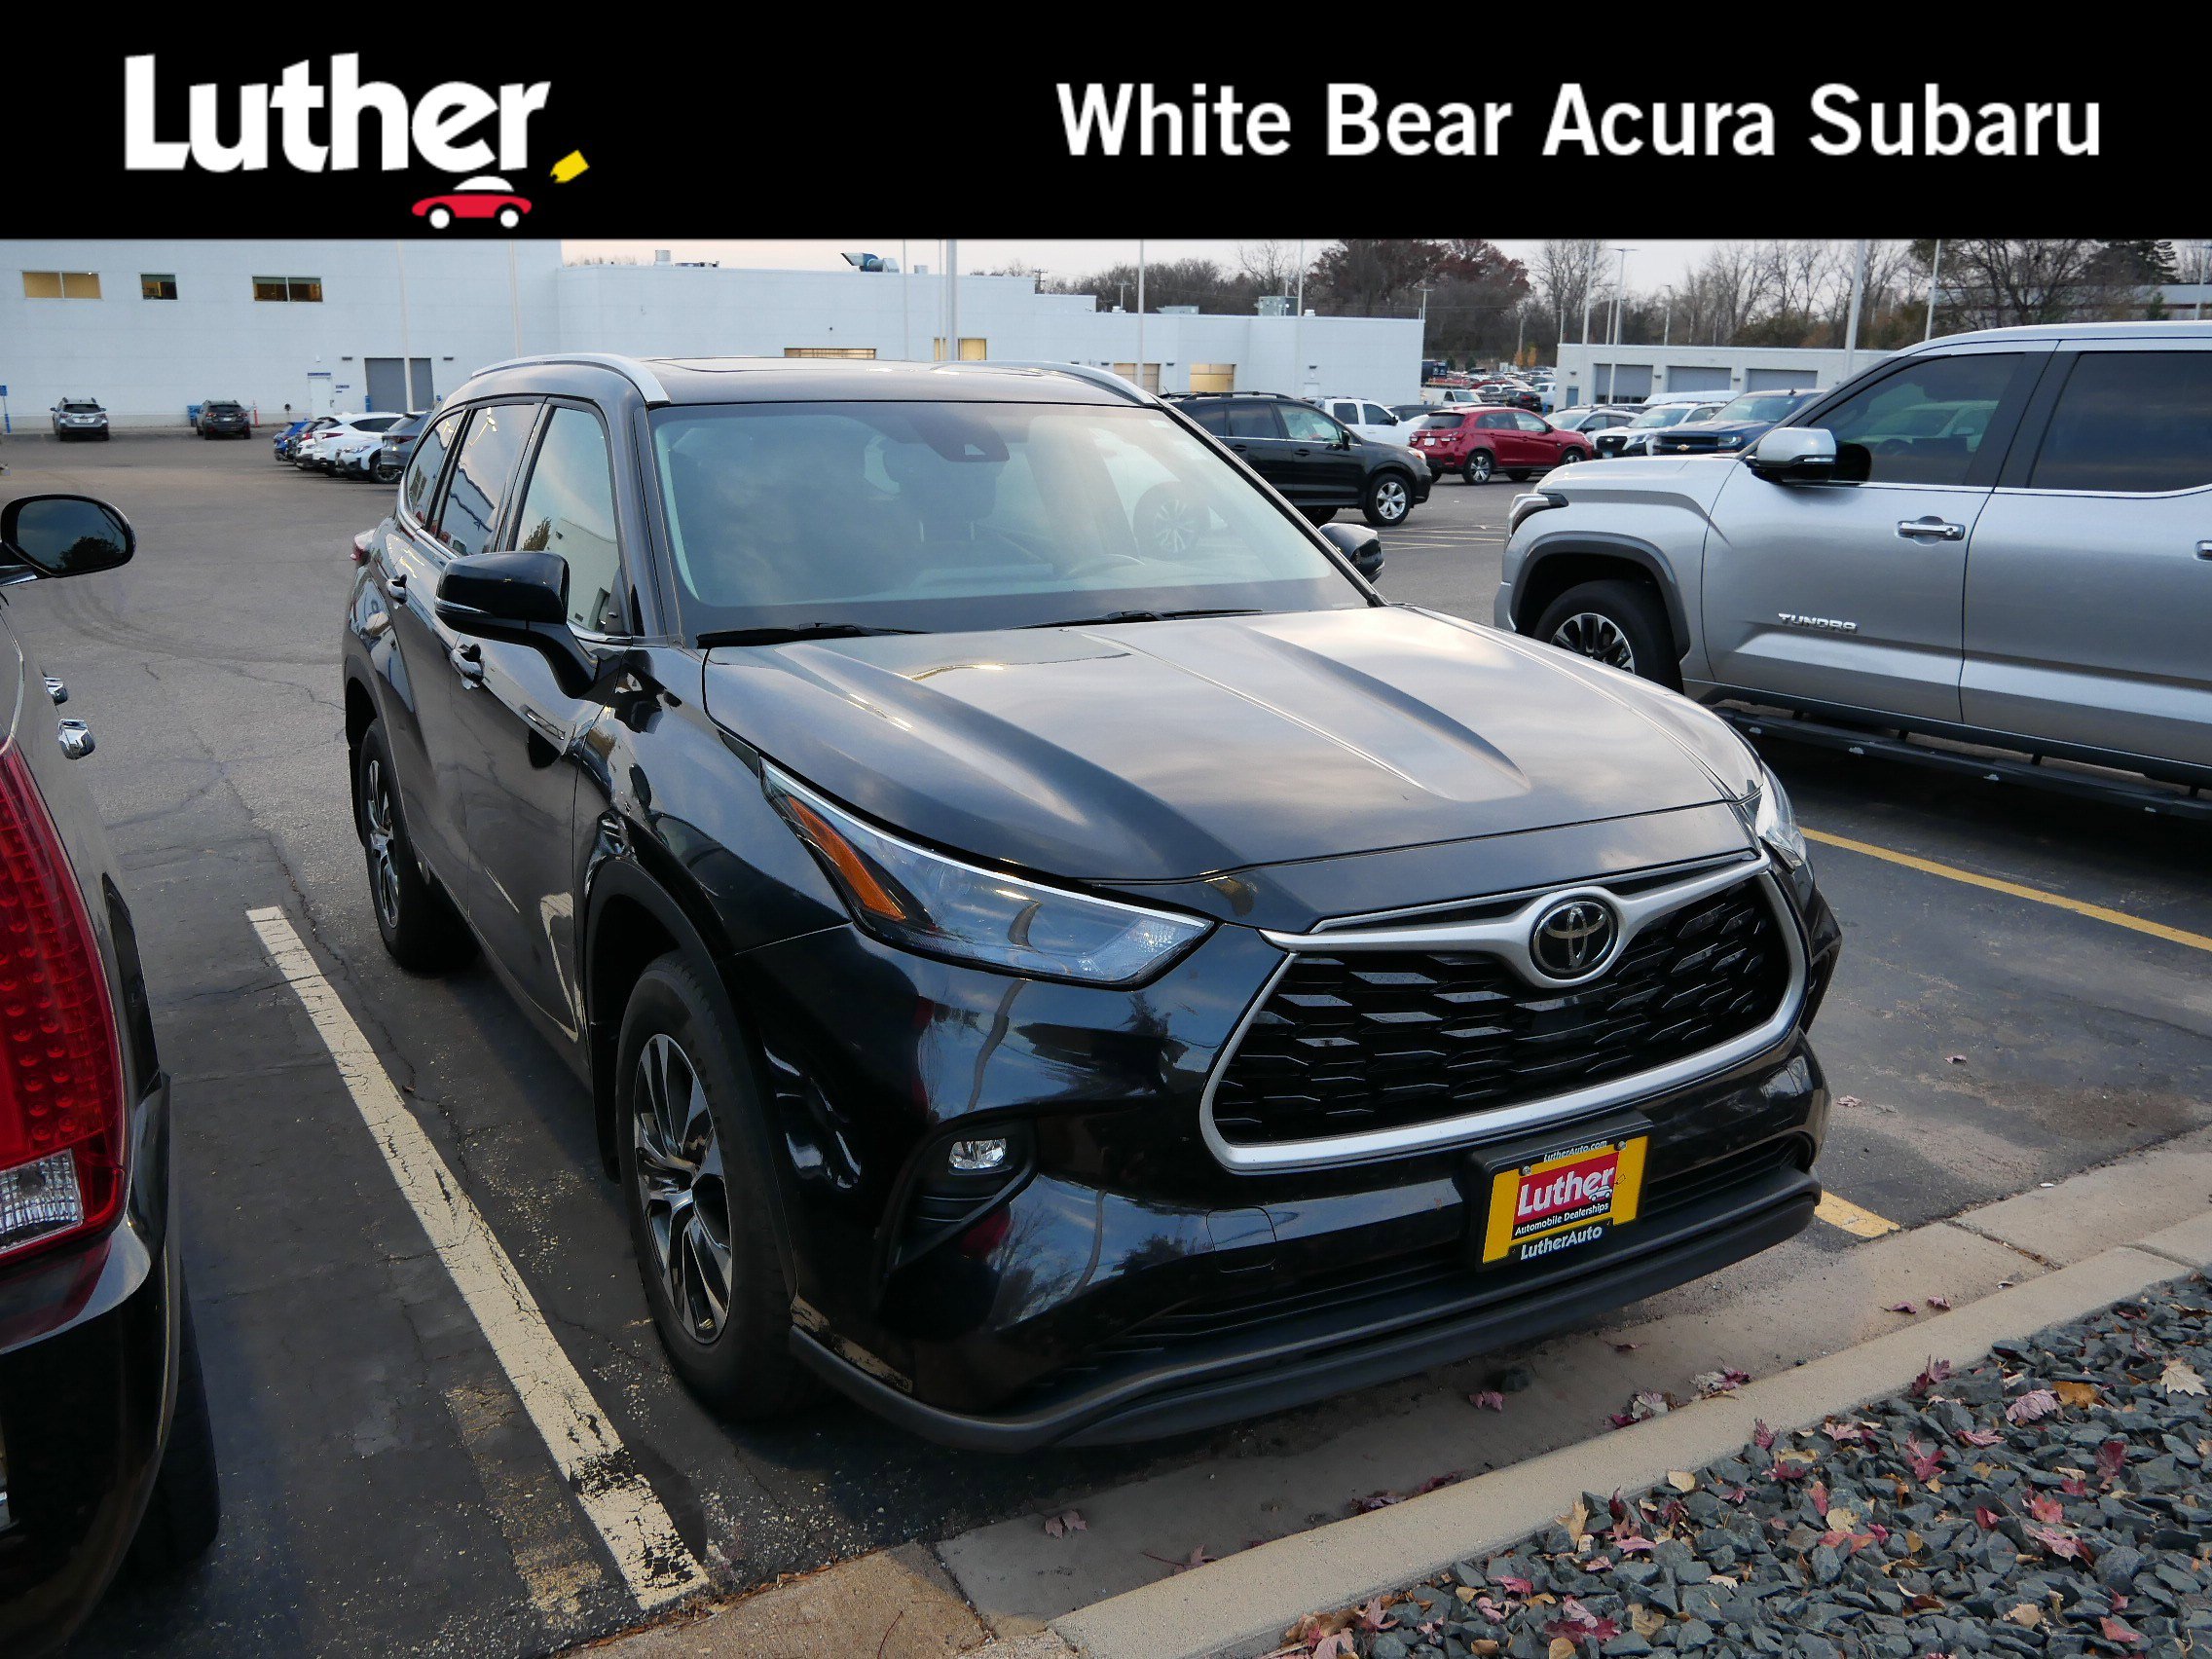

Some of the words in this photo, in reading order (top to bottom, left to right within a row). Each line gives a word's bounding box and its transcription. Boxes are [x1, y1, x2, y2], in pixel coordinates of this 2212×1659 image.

[1778, 612, 1858, 633] TUNDRA
[1543, 1139, 1607, 1162] LutherAuto.com
[1517, 1166, 1615, 1217] Luther
[1514, 1213, 1563, 1236] Automobile
[1563, 1201, 1609, 1222] Dealerships
[1520, 1225, 1603, 1261] LutherAuto
